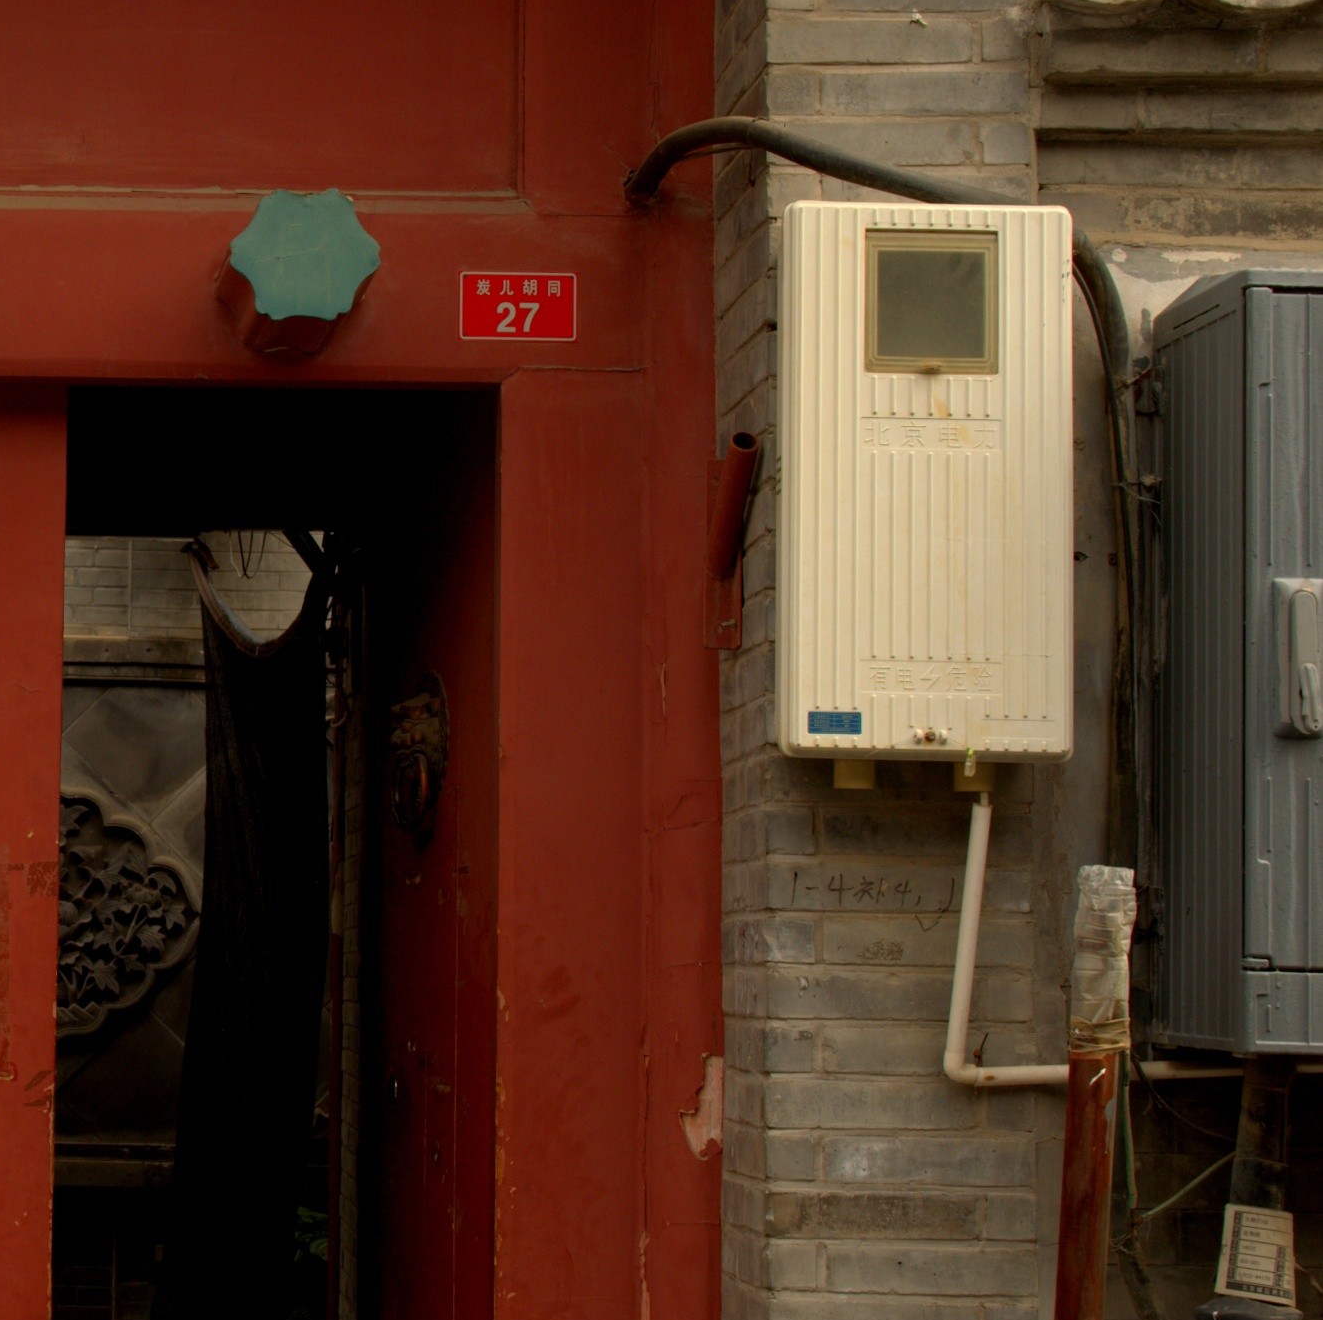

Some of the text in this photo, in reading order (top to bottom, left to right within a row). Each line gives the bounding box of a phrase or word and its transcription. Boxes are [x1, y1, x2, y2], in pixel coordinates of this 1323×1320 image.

[477, 279, 561, 297] 炭儿胡同
[496, 301, 540, 333] 27
[864, 420, 998, 449] 北京电力
